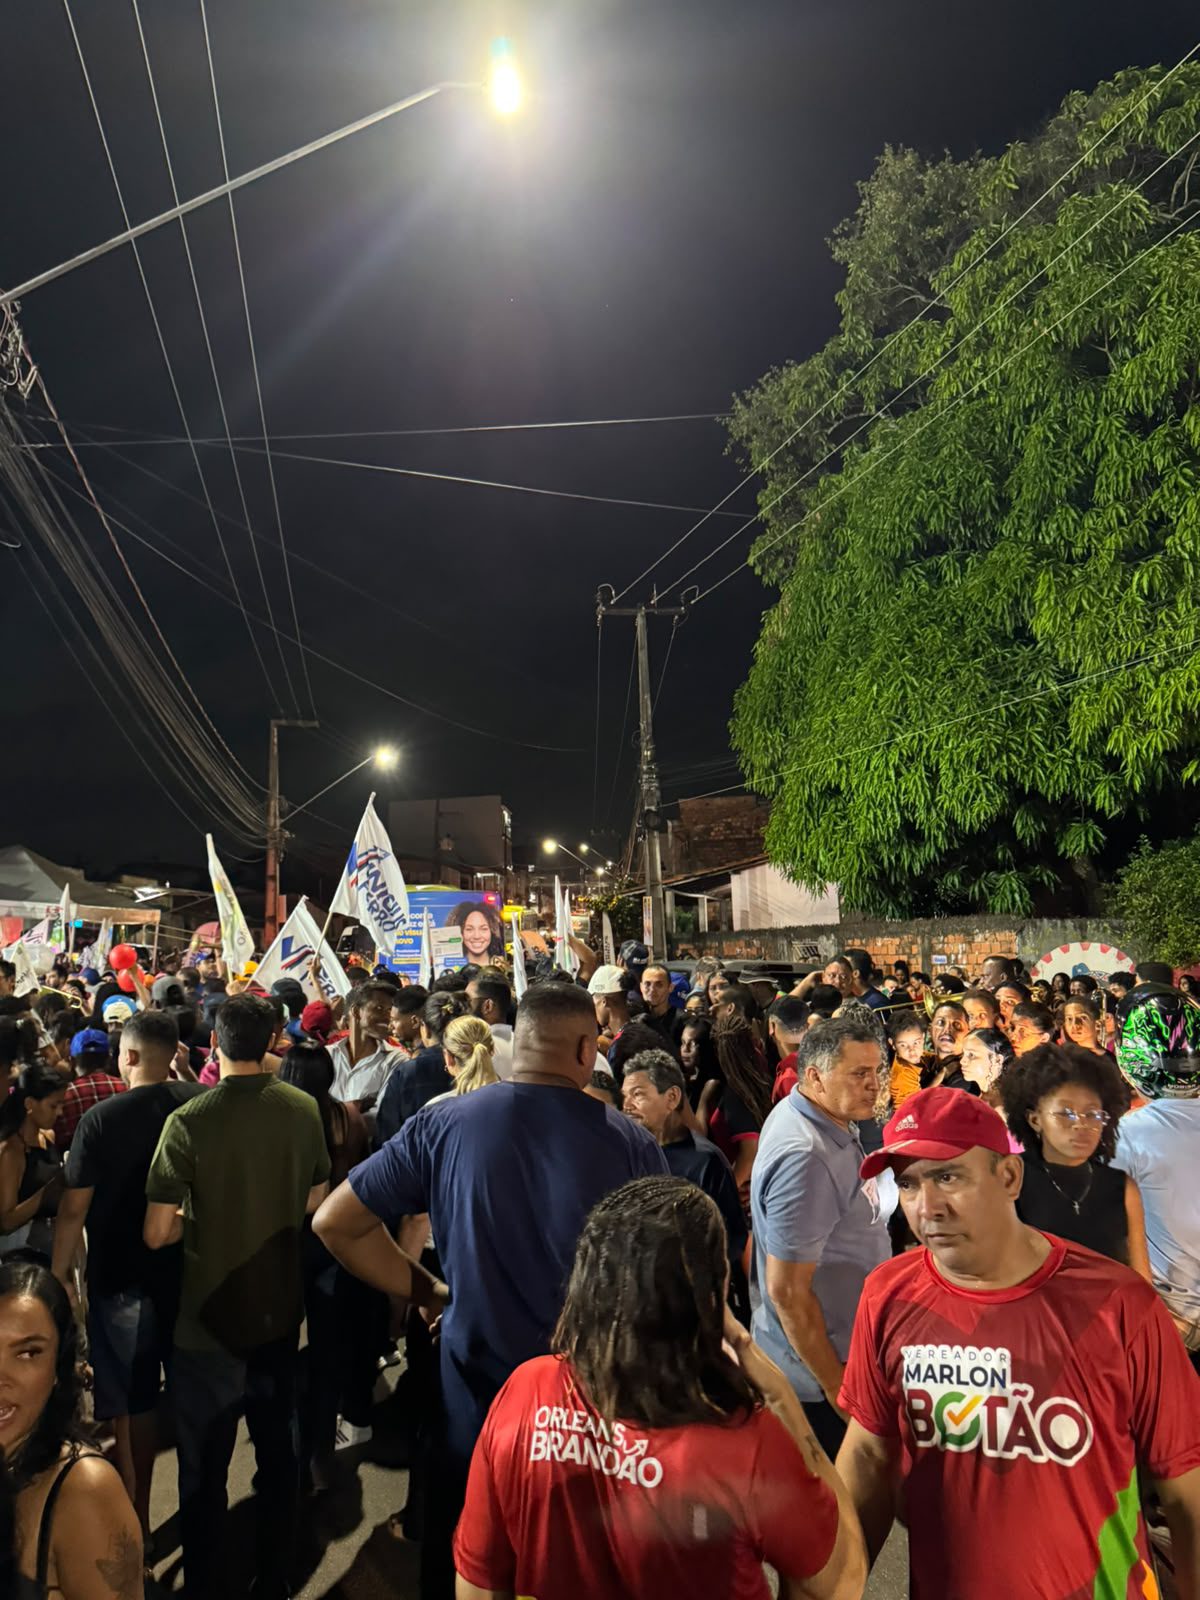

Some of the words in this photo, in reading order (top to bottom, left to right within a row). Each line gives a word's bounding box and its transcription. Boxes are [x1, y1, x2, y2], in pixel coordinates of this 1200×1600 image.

[905, 1349, 1008, 1363] VEREADOR
[905, 1363, 1007, 1389] MARLON
[535, 1405, 627, 1446] ORLEANS
[907, 1388, 1088, 1460] BOTÃO
